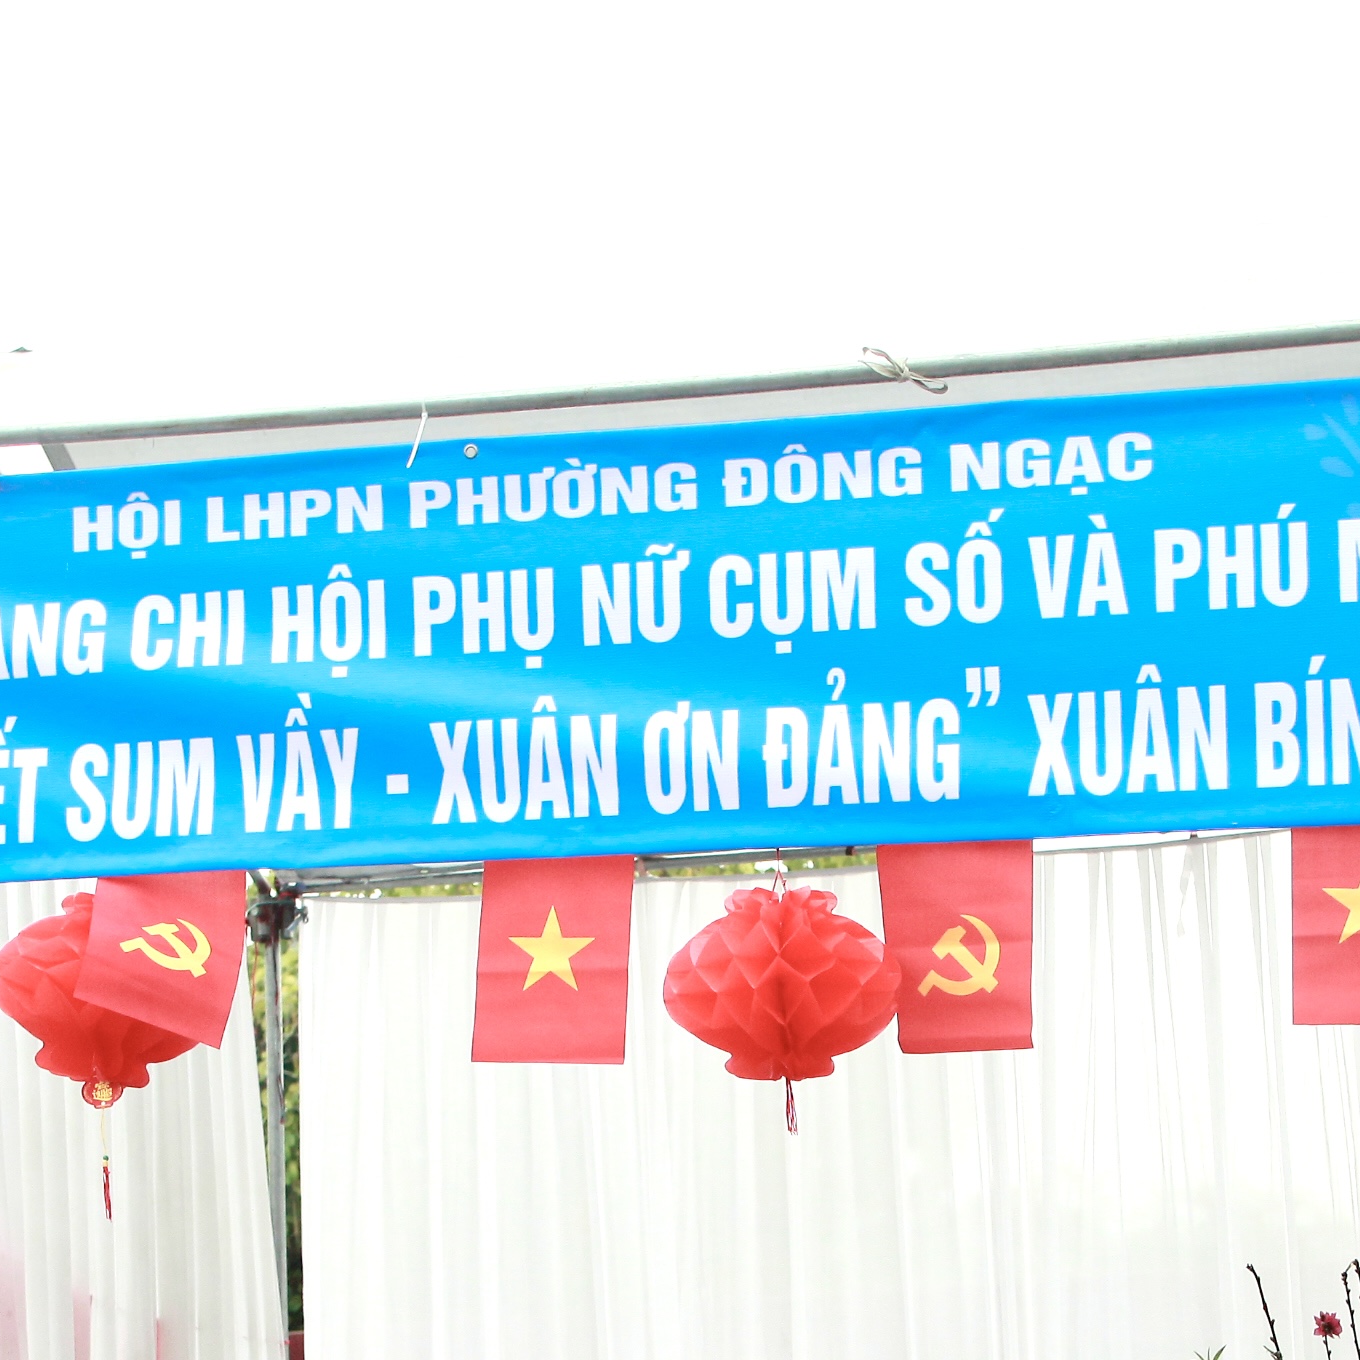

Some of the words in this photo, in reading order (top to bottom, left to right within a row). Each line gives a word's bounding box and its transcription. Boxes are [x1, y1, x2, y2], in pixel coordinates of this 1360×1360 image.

[74, 493, 180, 558] HỘI
[208, 485, 382, 542] LHPN
[410, 459, 697, 528] PHƯỜNG
[723, 444, 921, 506] ĐÔNG
[951, 433, 1153, 494] NGẠC
[131, 590, 244, 670] CHI
[272, 565, 385, 678] HỘI
[414, 568, 554, 669] PHỤ
[582, 544, 689, 645] NỮ
[710, 548, 875, 653] CỤM
[906, 509, 1003, 625] SỐ
[1029, 515, 1128, 617] VÀ
[1155, 504, 1307, 611] PHÚ
[67, 734, 214, 841] SUM
[237, 692, 358, 832] VẦY
[388, 775, 408, 793] -
[430, 696, 618, 823] XUÂN
[643, 700, 739, 813] ƠN
[1028, 664, 1227, 796] XUÂN
